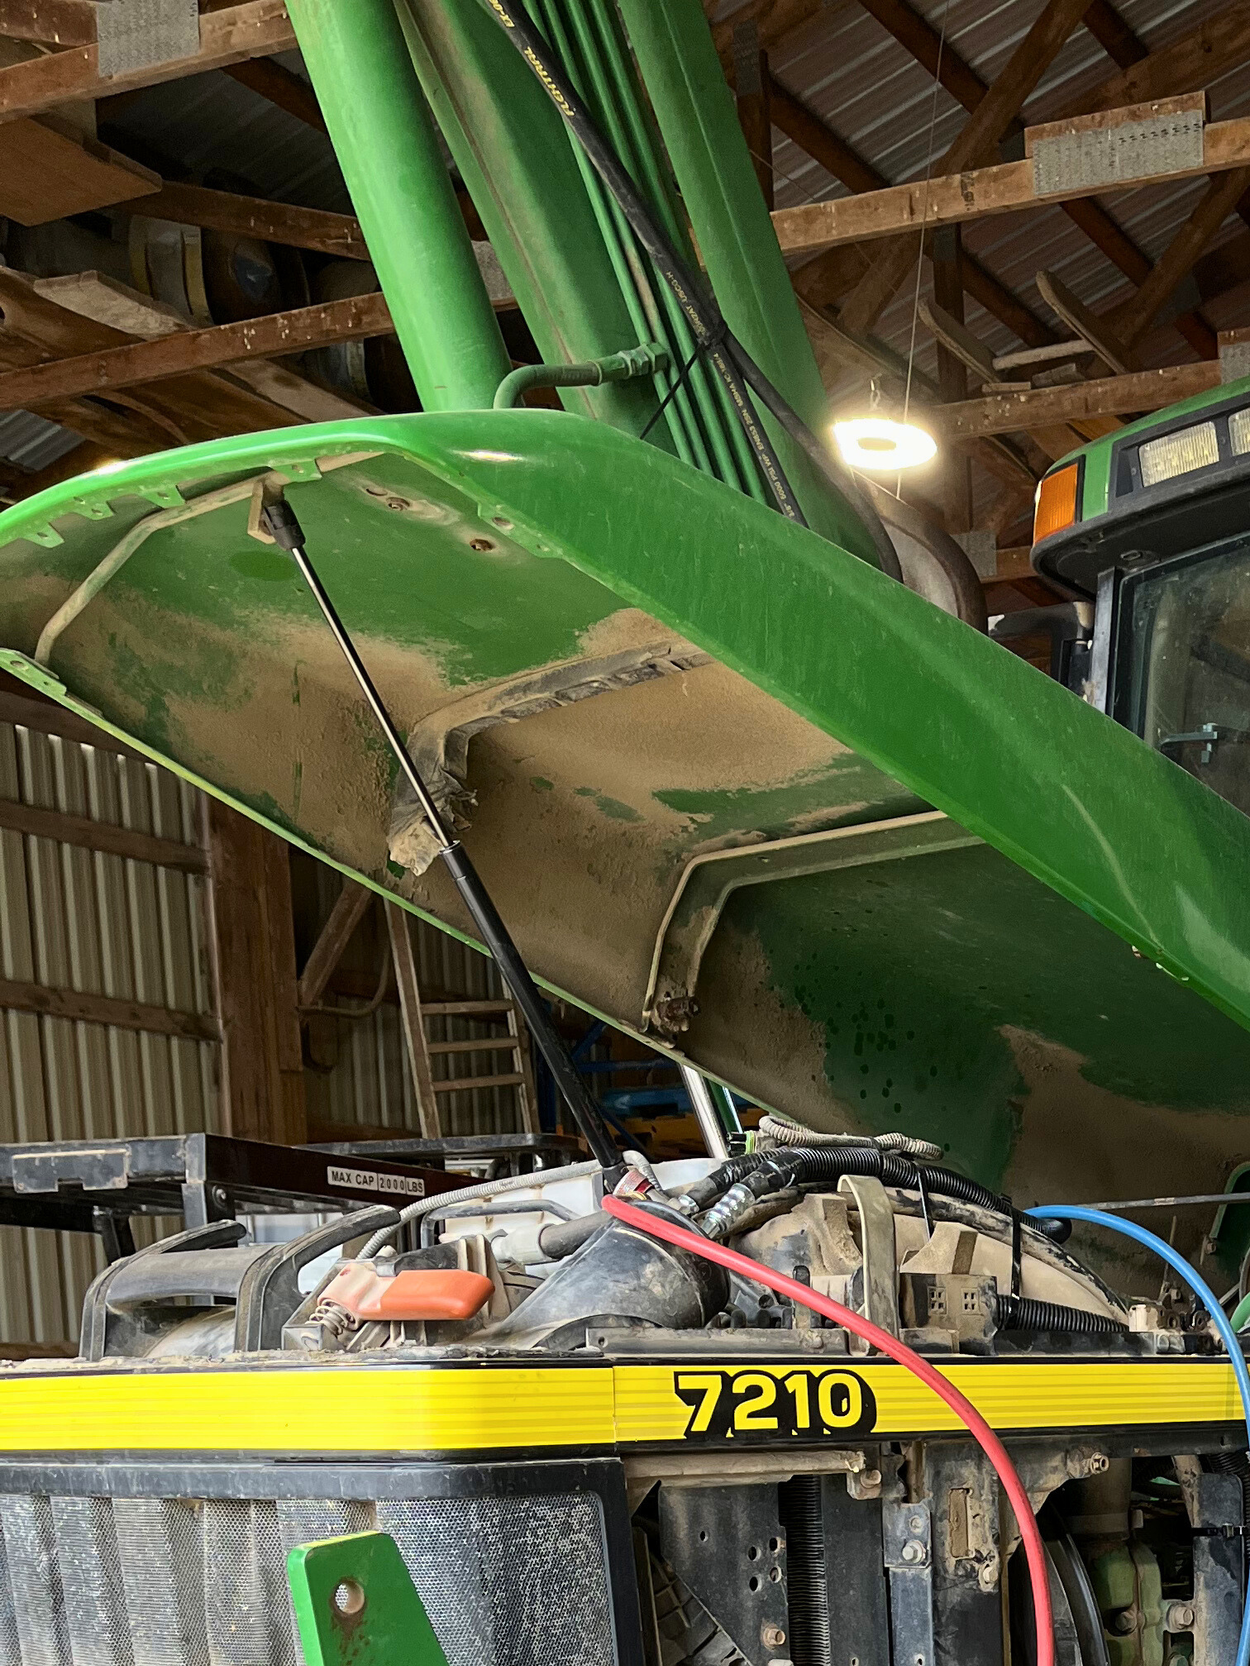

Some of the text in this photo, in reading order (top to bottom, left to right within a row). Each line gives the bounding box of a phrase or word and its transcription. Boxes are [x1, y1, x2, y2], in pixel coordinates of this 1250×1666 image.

[331, 1170, 424, 1193] MAX CAP 2000 LBS
[676, 1371, 868, 1435] 7210
